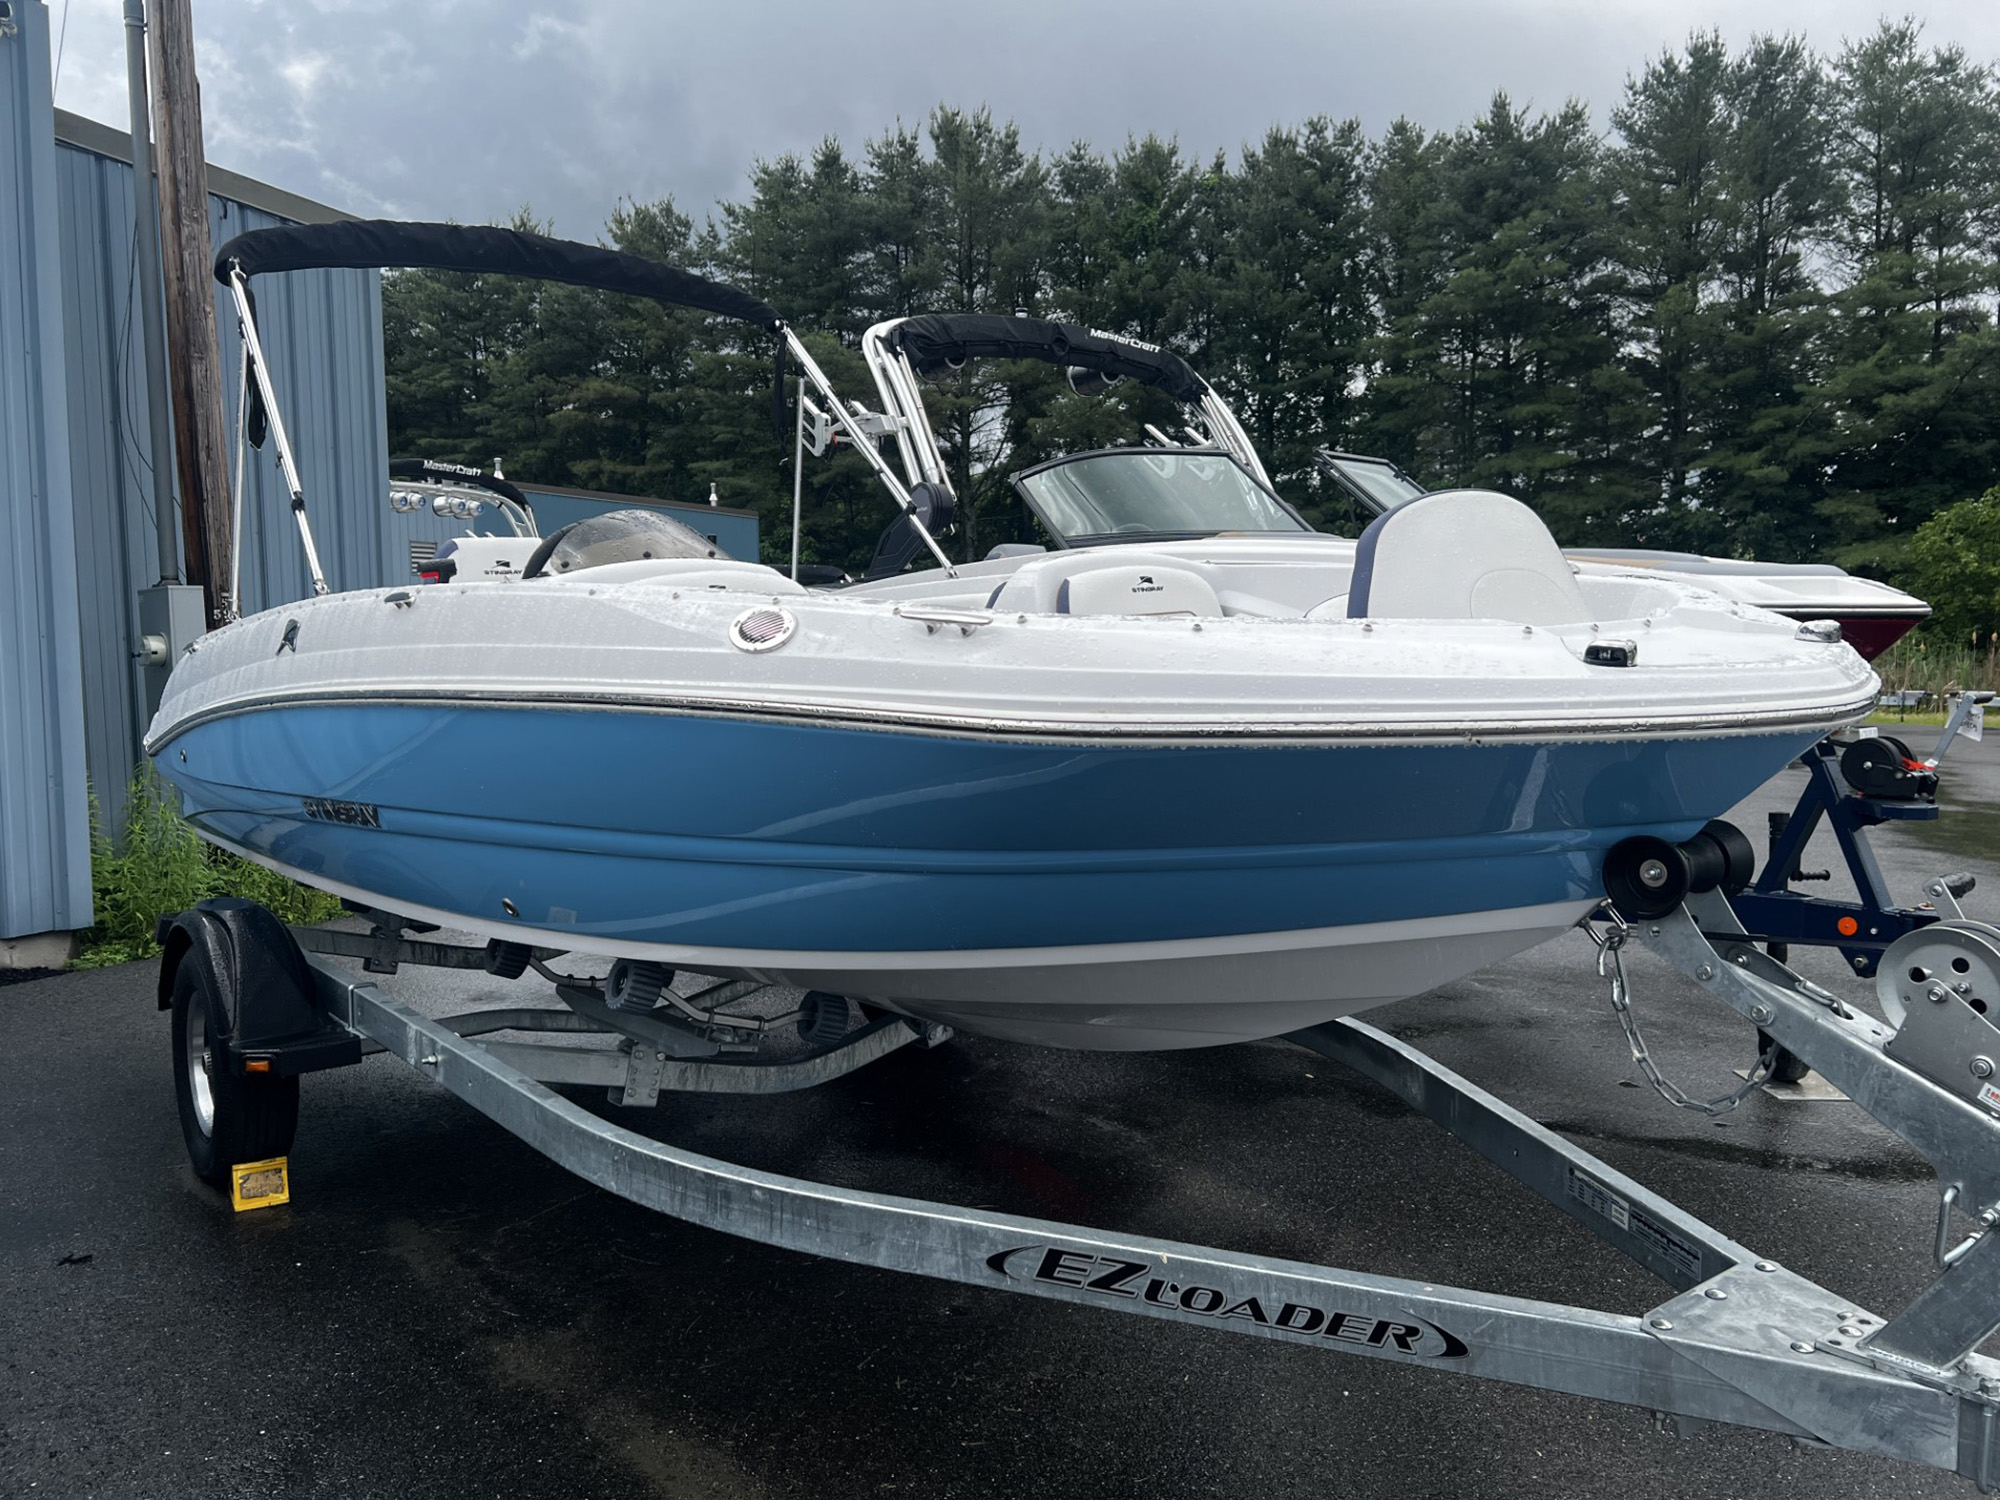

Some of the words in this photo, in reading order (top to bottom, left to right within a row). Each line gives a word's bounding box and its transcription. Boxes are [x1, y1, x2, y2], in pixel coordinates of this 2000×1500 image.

[1090, 328, 1161, 353] MasterCraft
[423, 459, 482, 477] MasterCraft
[1131, 585, 1164, 593] STINGRAY
